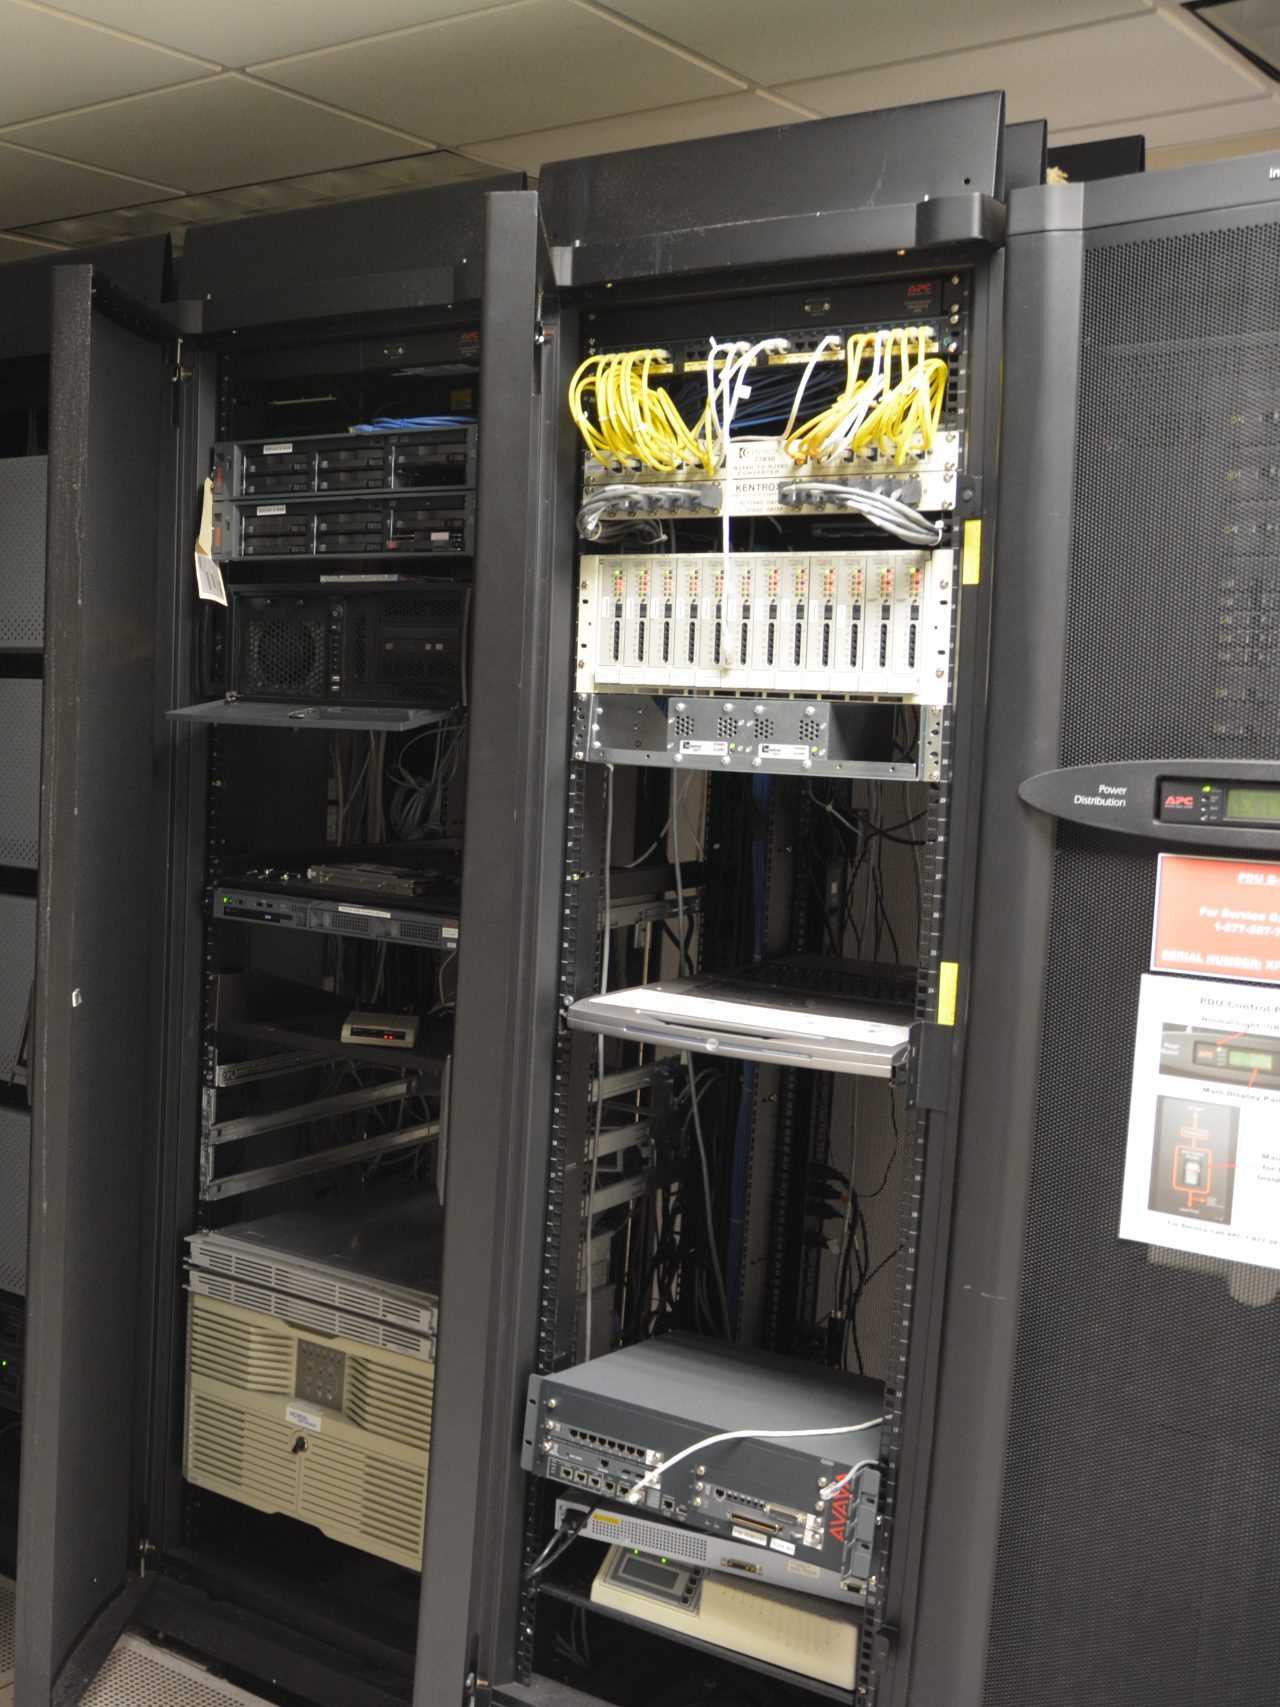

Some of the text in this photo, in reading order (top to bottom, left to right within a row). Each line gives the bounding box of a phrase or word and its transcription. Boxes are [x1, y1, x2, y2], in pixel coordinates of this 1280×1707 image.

[1098, 784, 1127, 795] Power
[1073, 795, 1126, 807] Distribution
[1164, 795, 1194, 806] APC
[1237, 872, 1264, 884] PDU
[1199, 906, 1219, 917] For
[1221, 908, 1266, 922] Service
[1161, 948, 1204, 962] SERIAL
[1200, 997, 1223, 1007] PDU
[1227, 1000, 1270, 1013] Control
[1202, 1087, 1224, 1096] Main
[1227, 1090, 1260, 1102] Display
[829, 1472, 852, 1543] AVAYA
